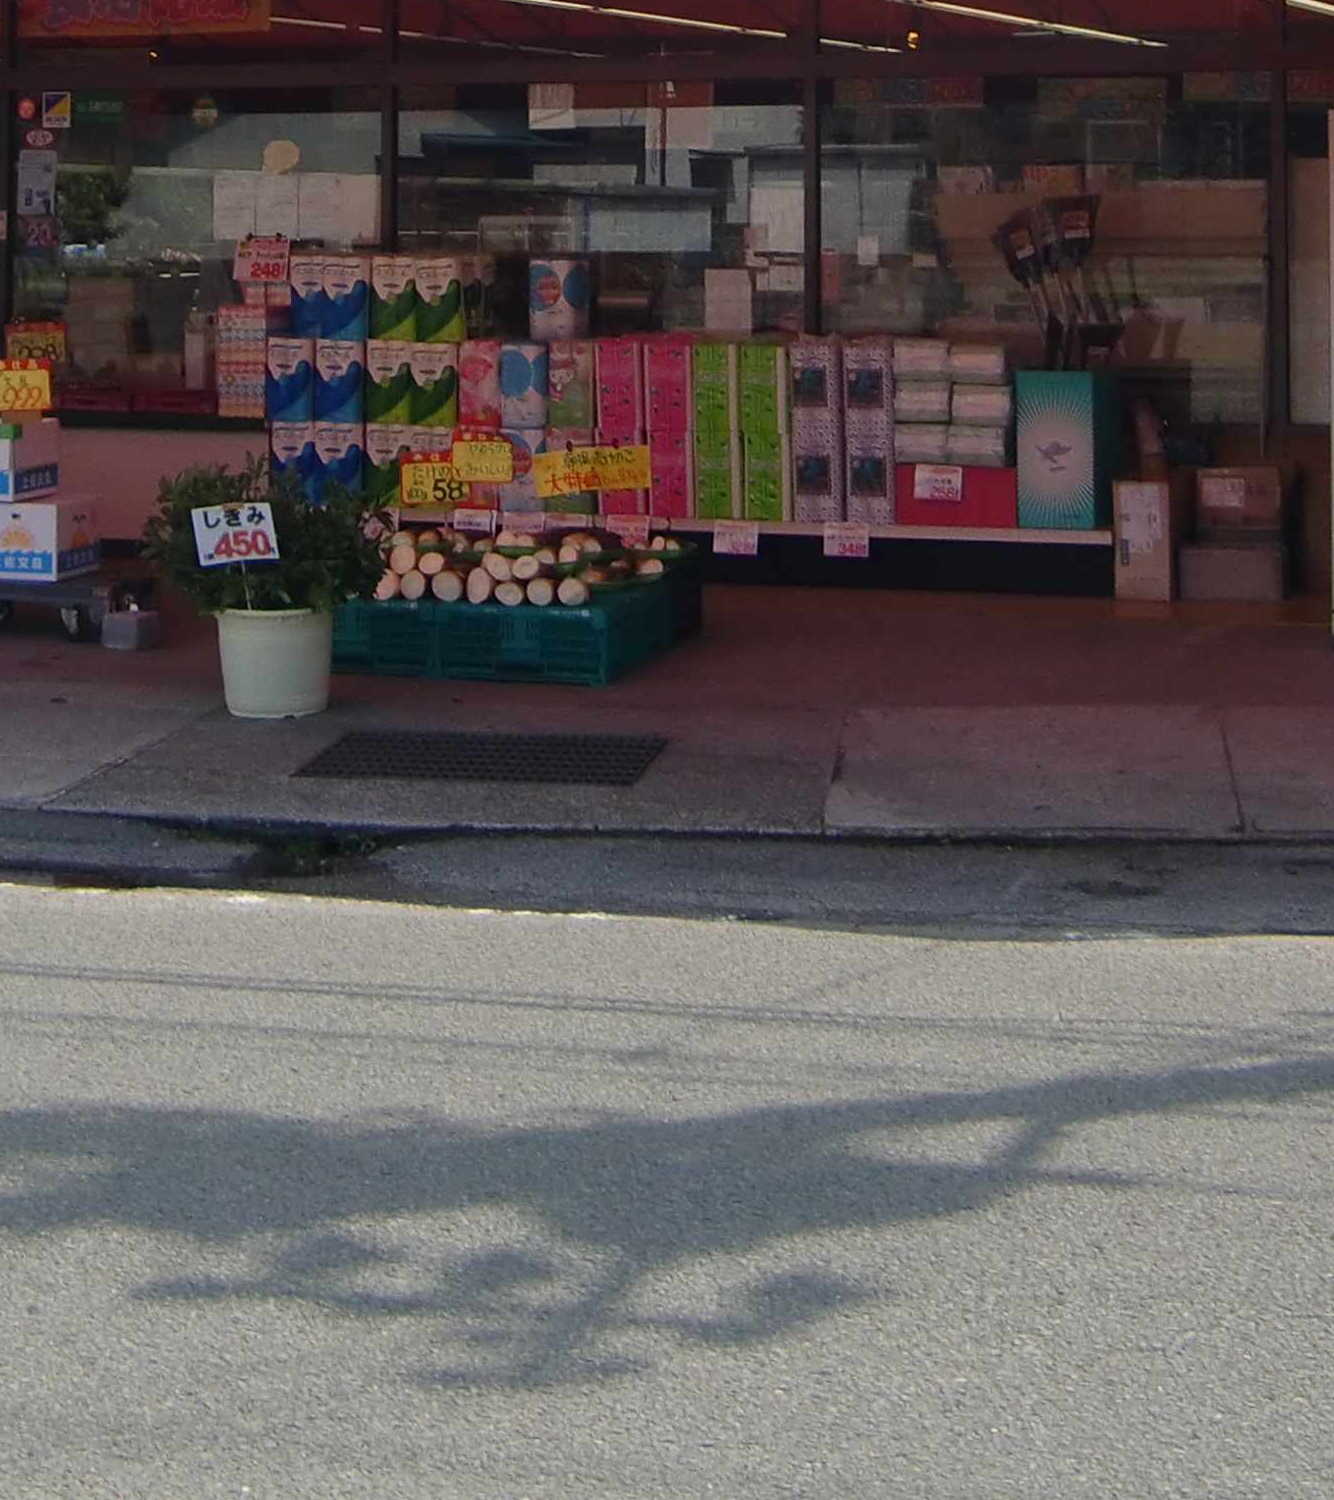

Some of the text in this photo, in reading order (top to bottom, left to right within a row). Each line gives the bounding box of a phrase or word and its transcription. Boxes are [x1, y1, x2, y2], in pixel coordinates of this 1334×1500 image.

[250, 262, 281, 280] 248
[2, 385, 42, 410] 999
[432, 479, 464, 501] 58
[202, 505, 266, 529] しきみ
[214, 528, 271, 558] 450
